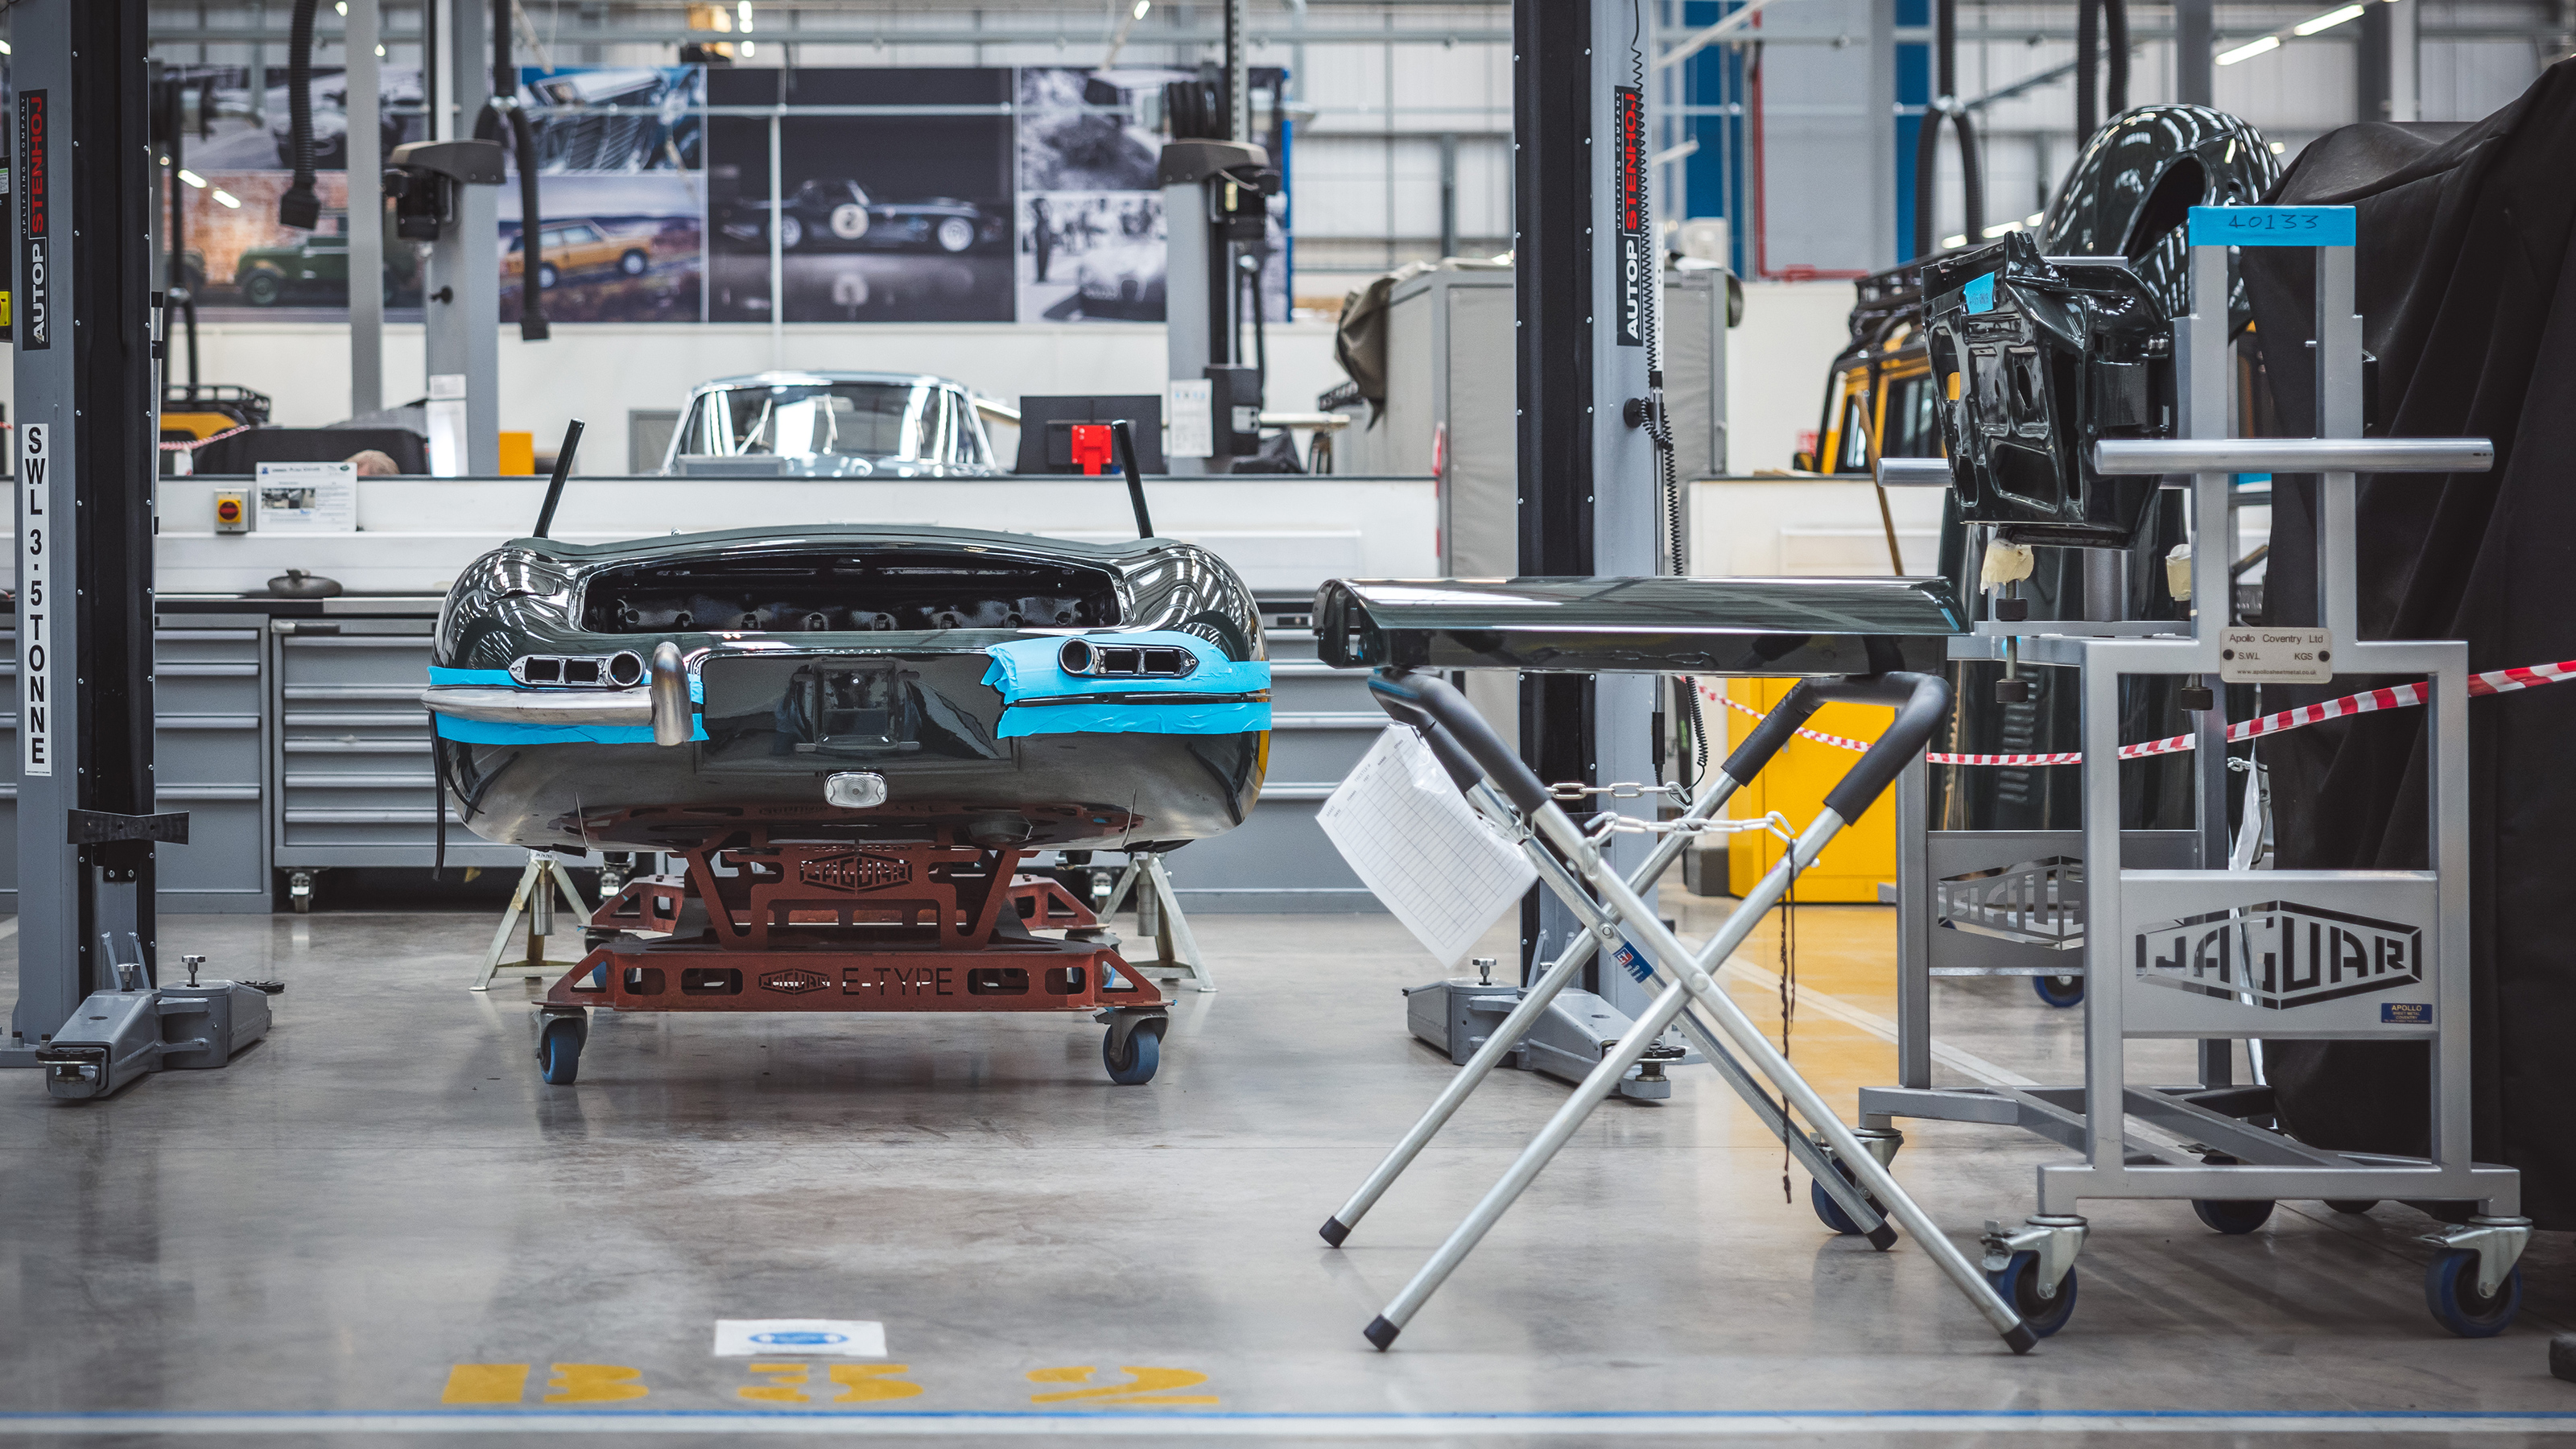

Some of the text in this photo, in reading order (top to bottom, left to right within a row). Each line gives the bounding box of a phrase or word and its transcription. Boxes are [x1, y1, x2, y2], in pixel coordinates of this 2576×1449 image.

[31, 97, 43, 233] STENHOJ
[1625, 93, 1637, 229] STENHOJ
[2228, 214, 2319, 229] 40133
[32, 243, 45, 342] AUTOP
[1626, 240, 1639, 339] AUTOP
[25, 427, 46, 516] SWL
[2229, 634, 2323, 644] Apollo Coventry Ltd
[29, 613, 46, 764] TONNE
[807, 857, 906, 888] JAGUAR
[762, 968, 954, 995] JAGUAR E-TYPE
[2155, 915, 2409, 994] JAGUAR
